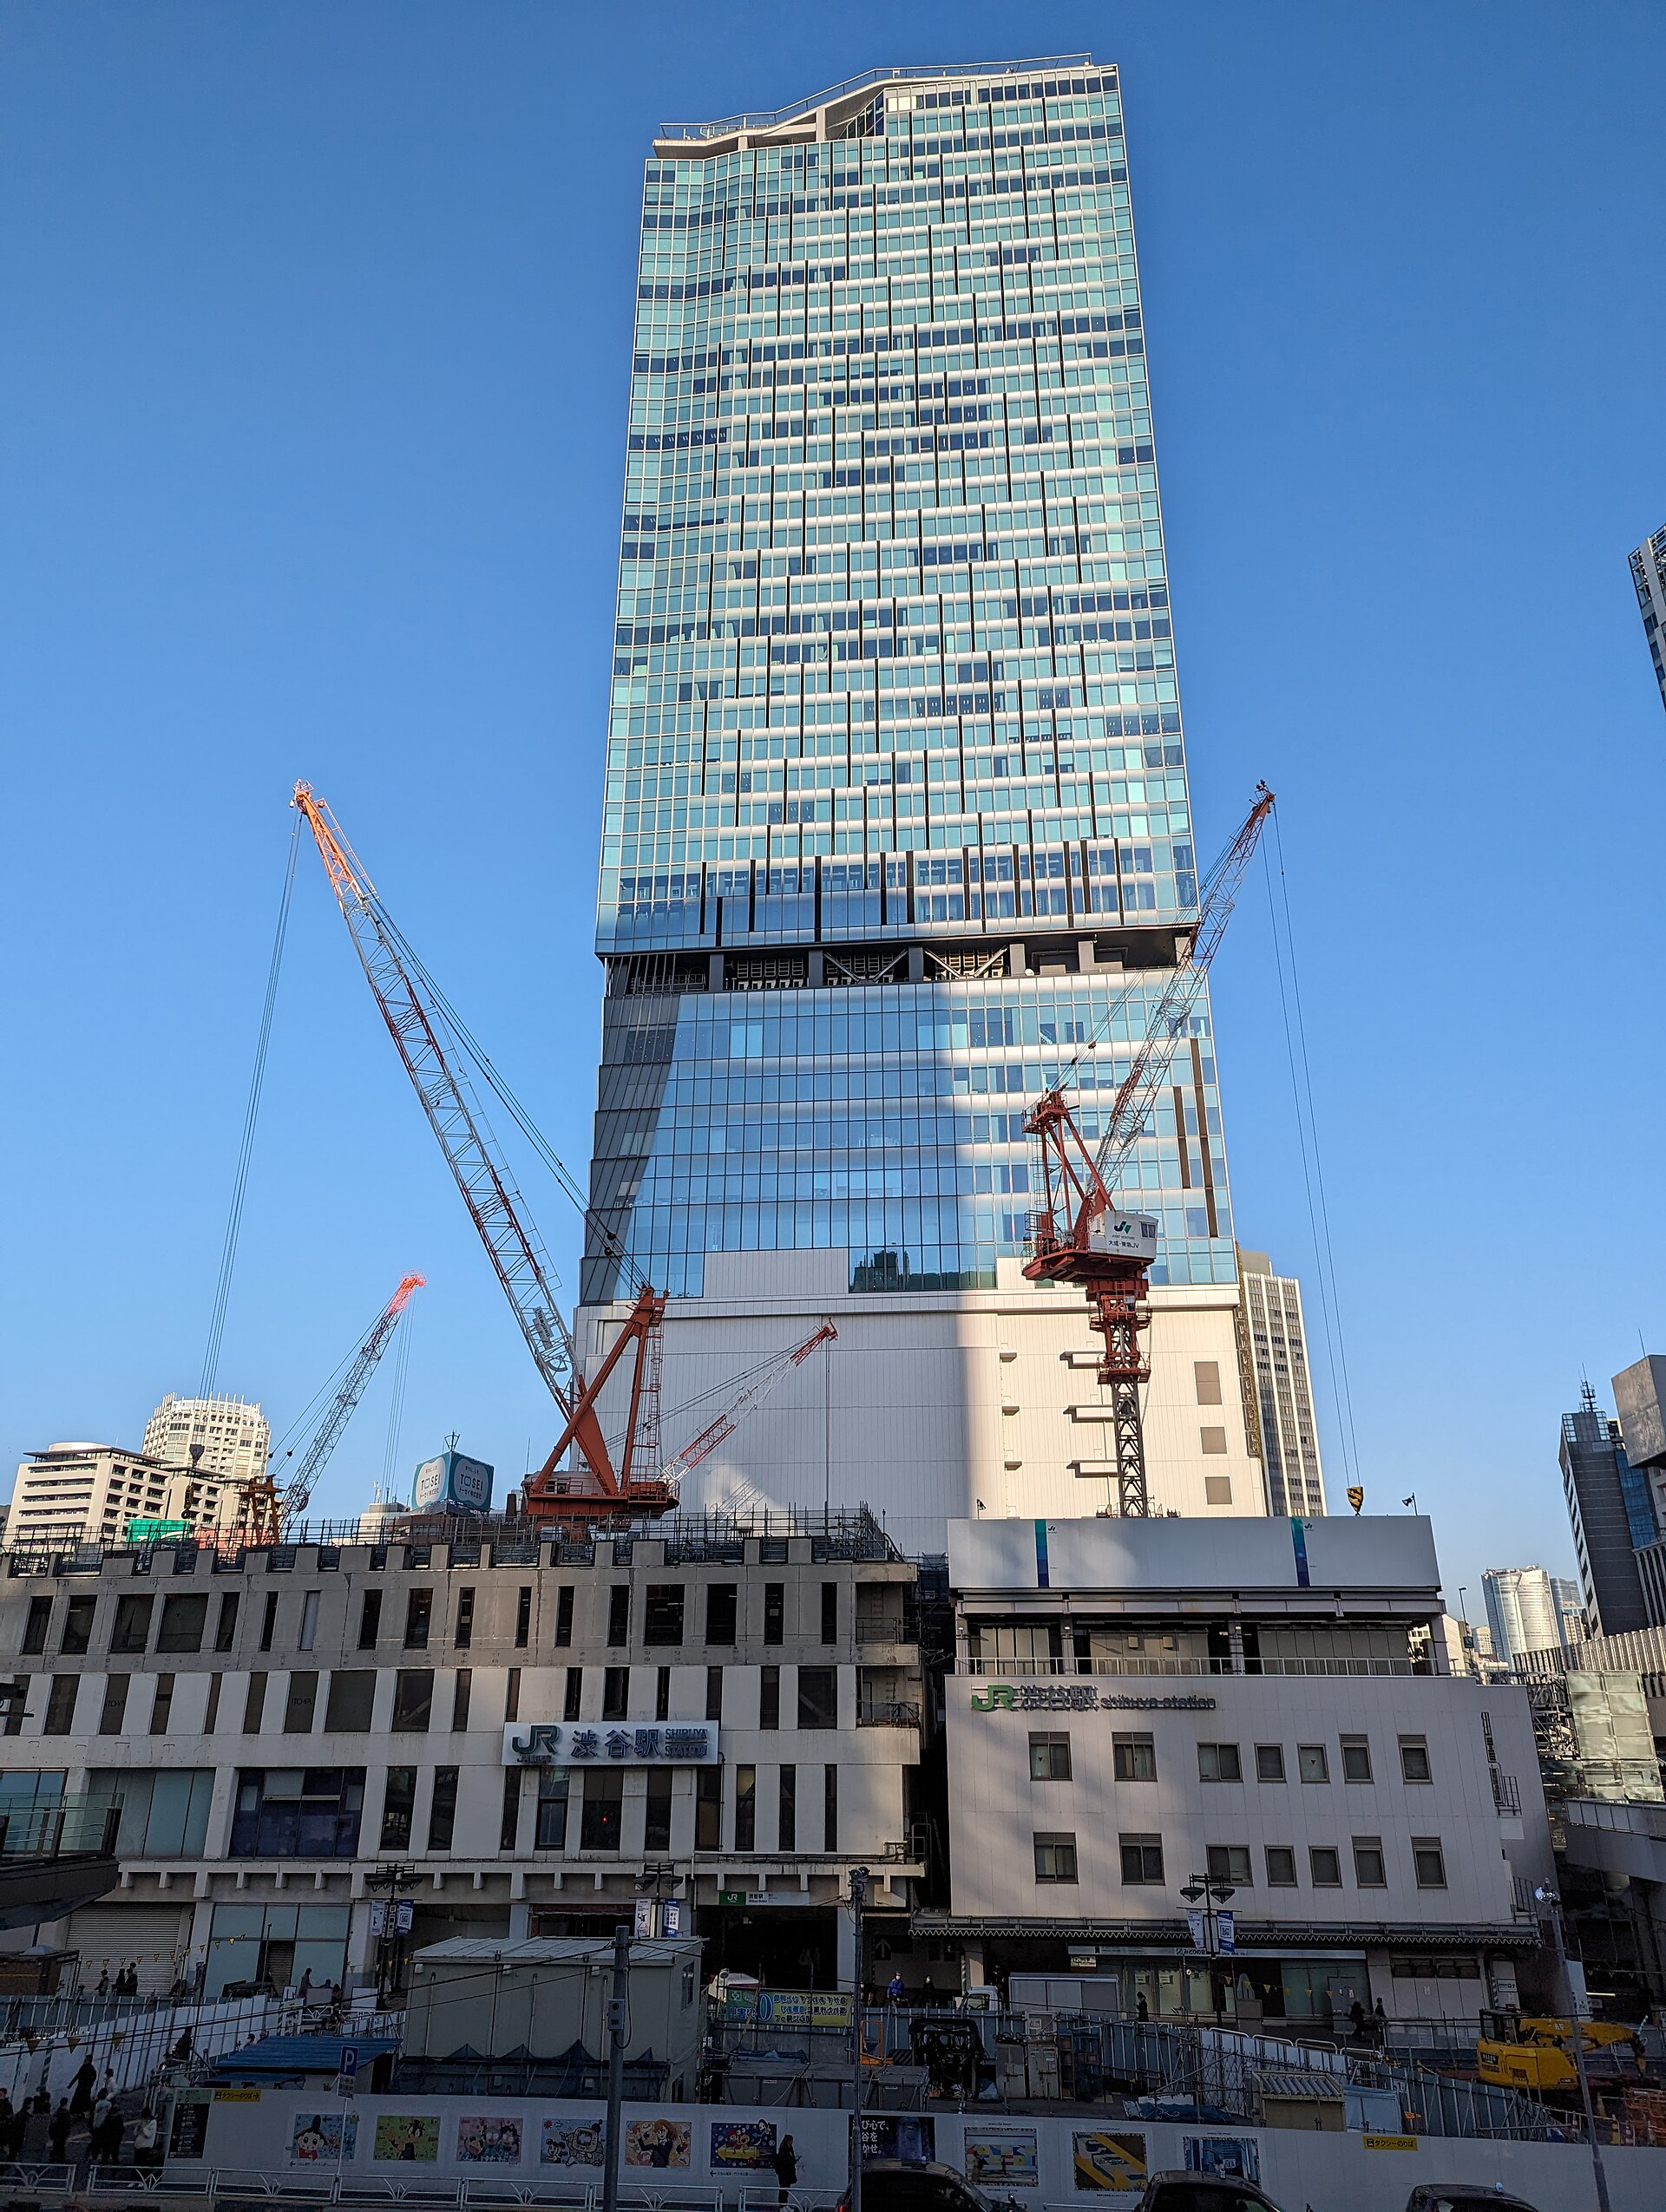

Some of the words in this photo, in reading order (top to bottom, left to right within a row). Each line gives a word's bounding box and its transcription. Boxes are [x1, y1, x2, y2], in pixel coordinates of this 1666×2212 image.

[421, 1474, 441, 1491] TOSEI
[460, 1473, 483, 1491] TOSEI
[971, 1685, 1015, 1711] JR
[1020, 1685, 1099, 1711] 渋谷駅
[1100, 1694, 1158, 1711] shibuya
[1163, 1694, 1217, 1709] station
[512, 1724, 560, 1755] JR
[570, 1729, 660, 1757] 渋谷駅
[665, 1728, 708, 1739] SHIBUYA
[665, 1744, 708, 1757] STATION
[344, 2049, 355, 2073] P
[853, 2119, 889, 2130] び心で、
[1374, 2138, 1413, 2148] タクシーのりば
